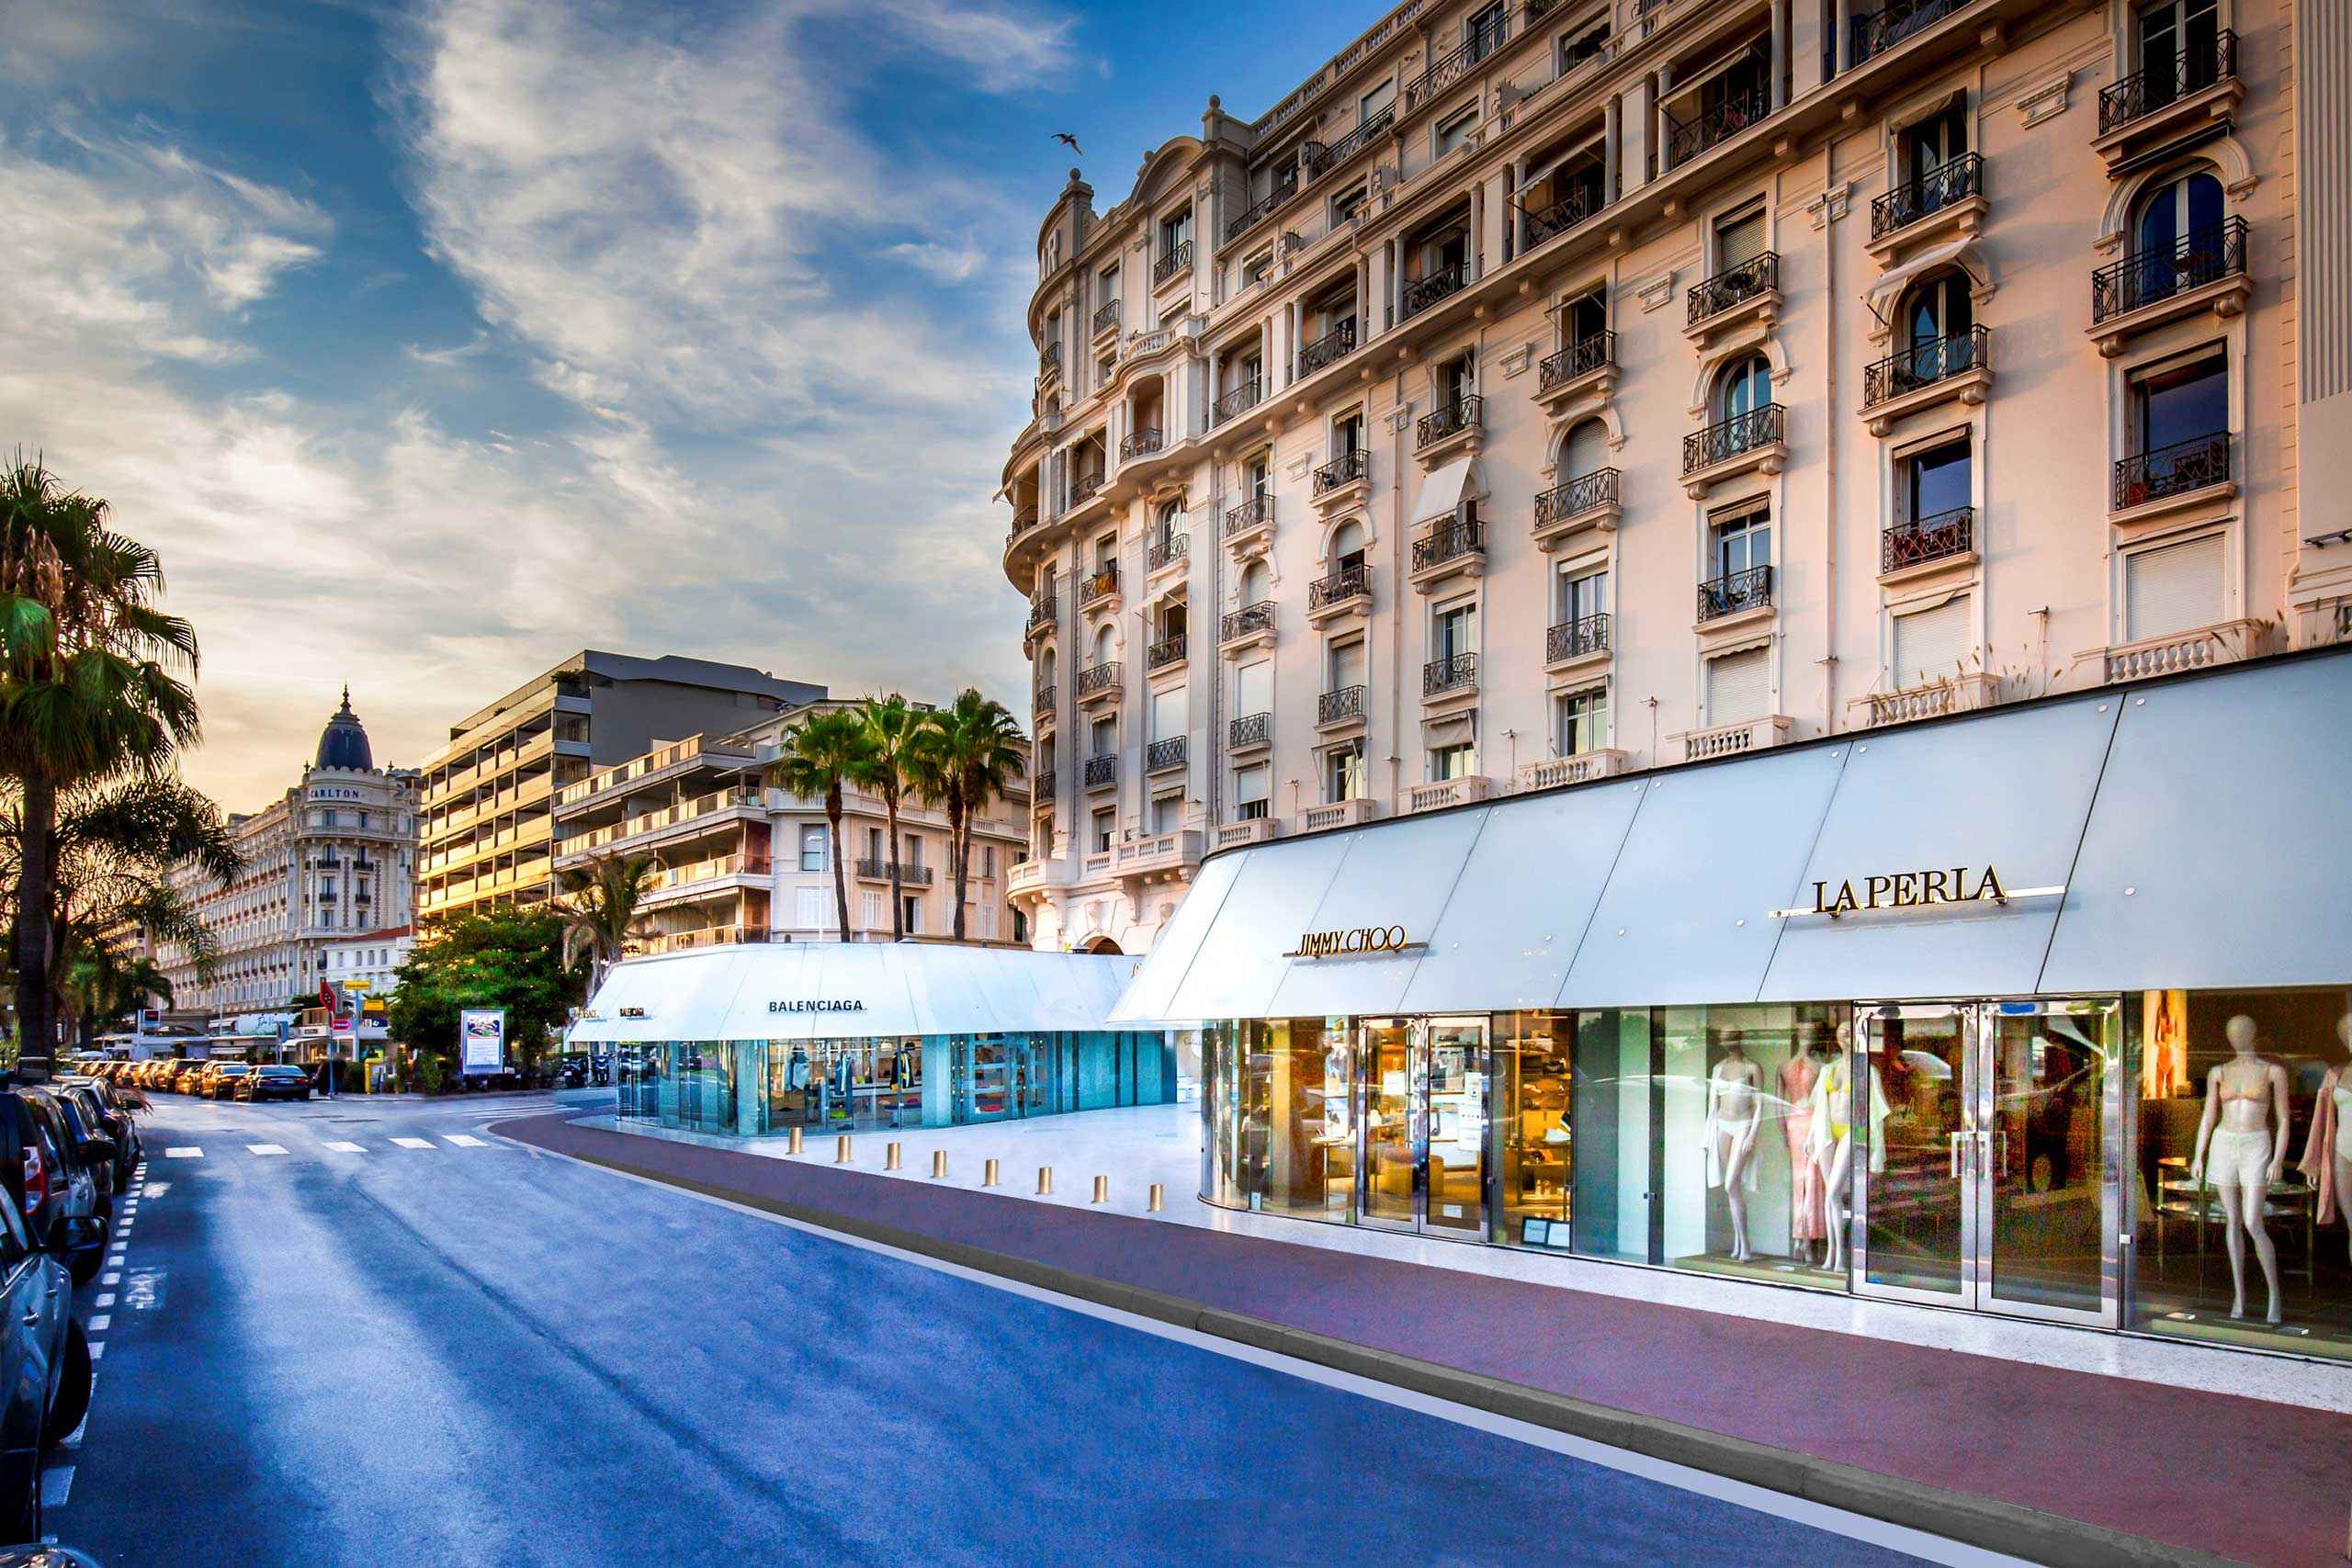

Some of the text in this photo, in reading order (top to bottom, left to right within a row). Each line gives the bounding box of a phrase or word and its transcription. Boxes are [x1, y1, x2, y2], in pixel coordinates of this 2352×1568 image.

[1812, 863, 2007, 913] LA PERLA
[1295, 925, 1406, 955] JIMMY CHOO
[769, 999, 863, 1012] BALENCIAGA
